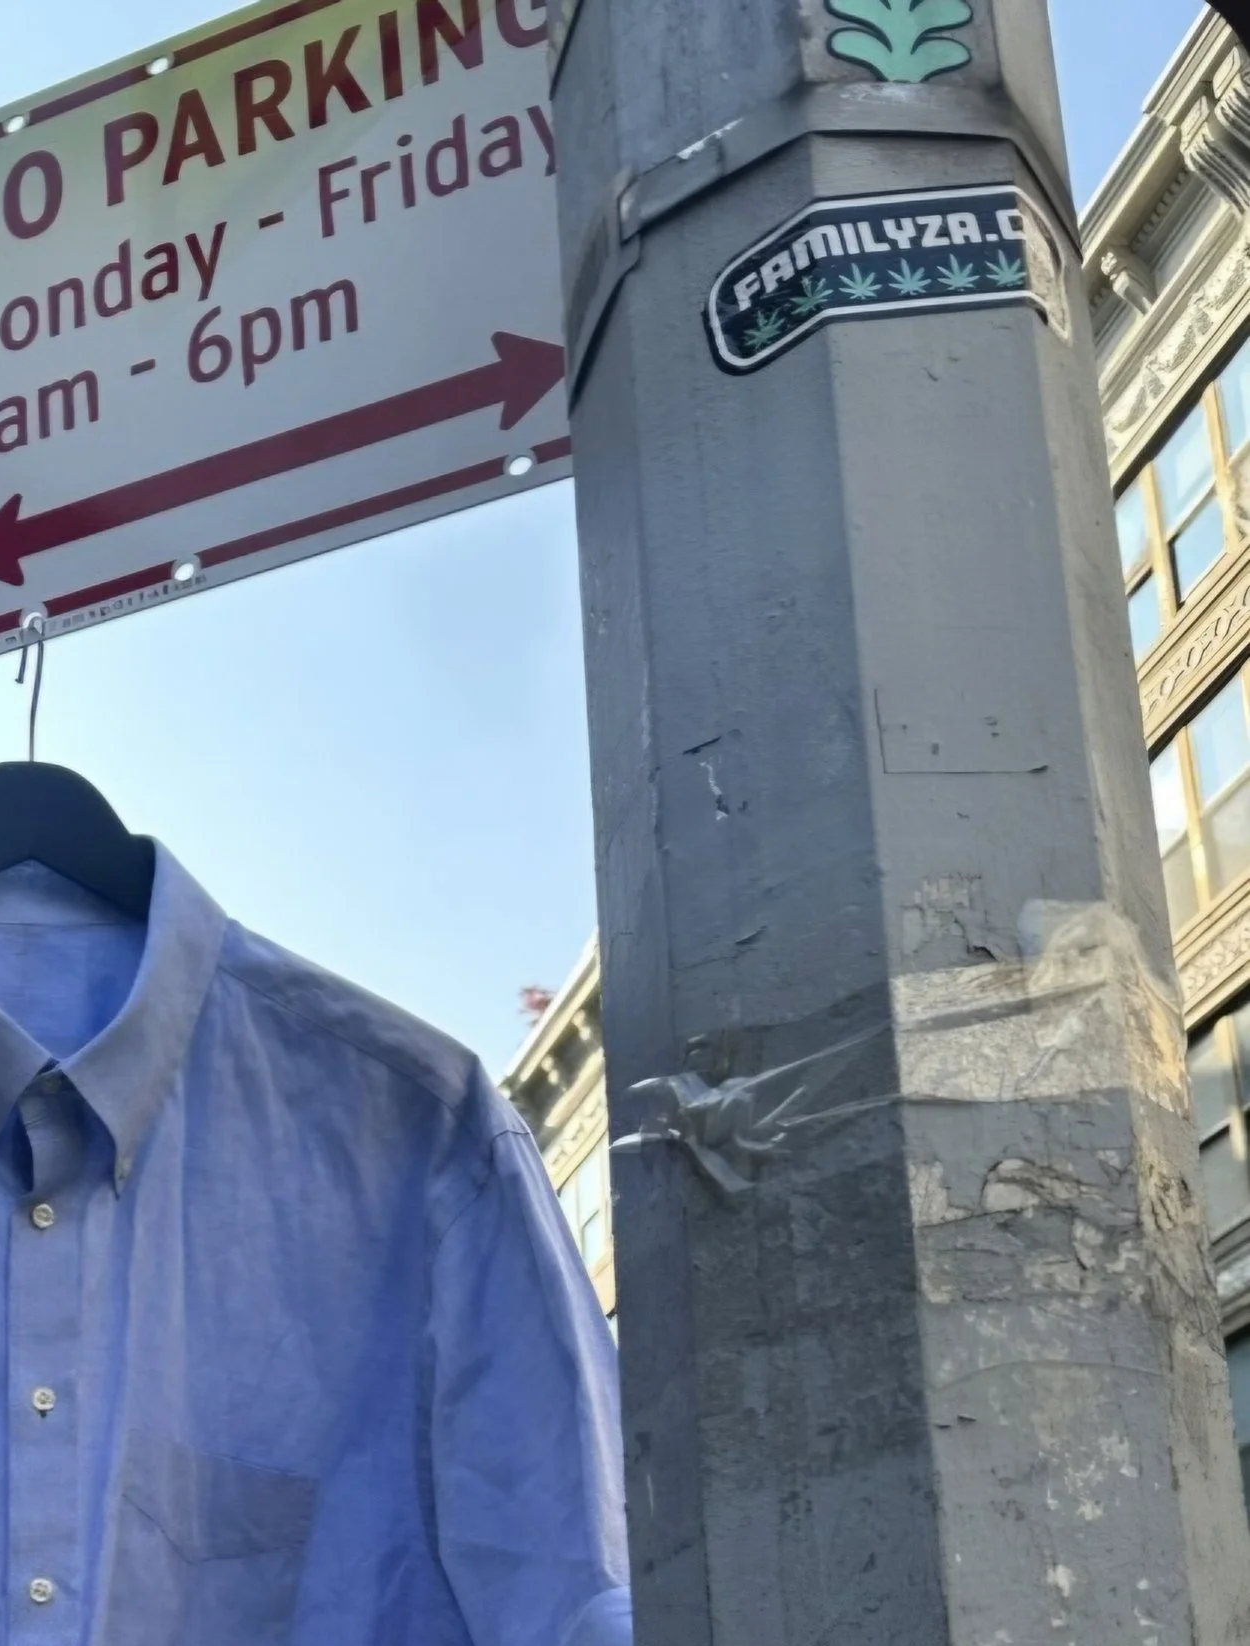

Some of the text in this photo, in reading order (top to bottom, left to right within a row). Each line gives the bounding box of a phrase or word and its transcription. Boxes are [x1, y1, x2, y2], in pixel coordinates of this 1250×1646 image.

[257, 210, 285, 230] -
[317, 104, 557, 239] Friday
[129, 356, 156, 377] -
[187, 277, 360, 389] 6pm
